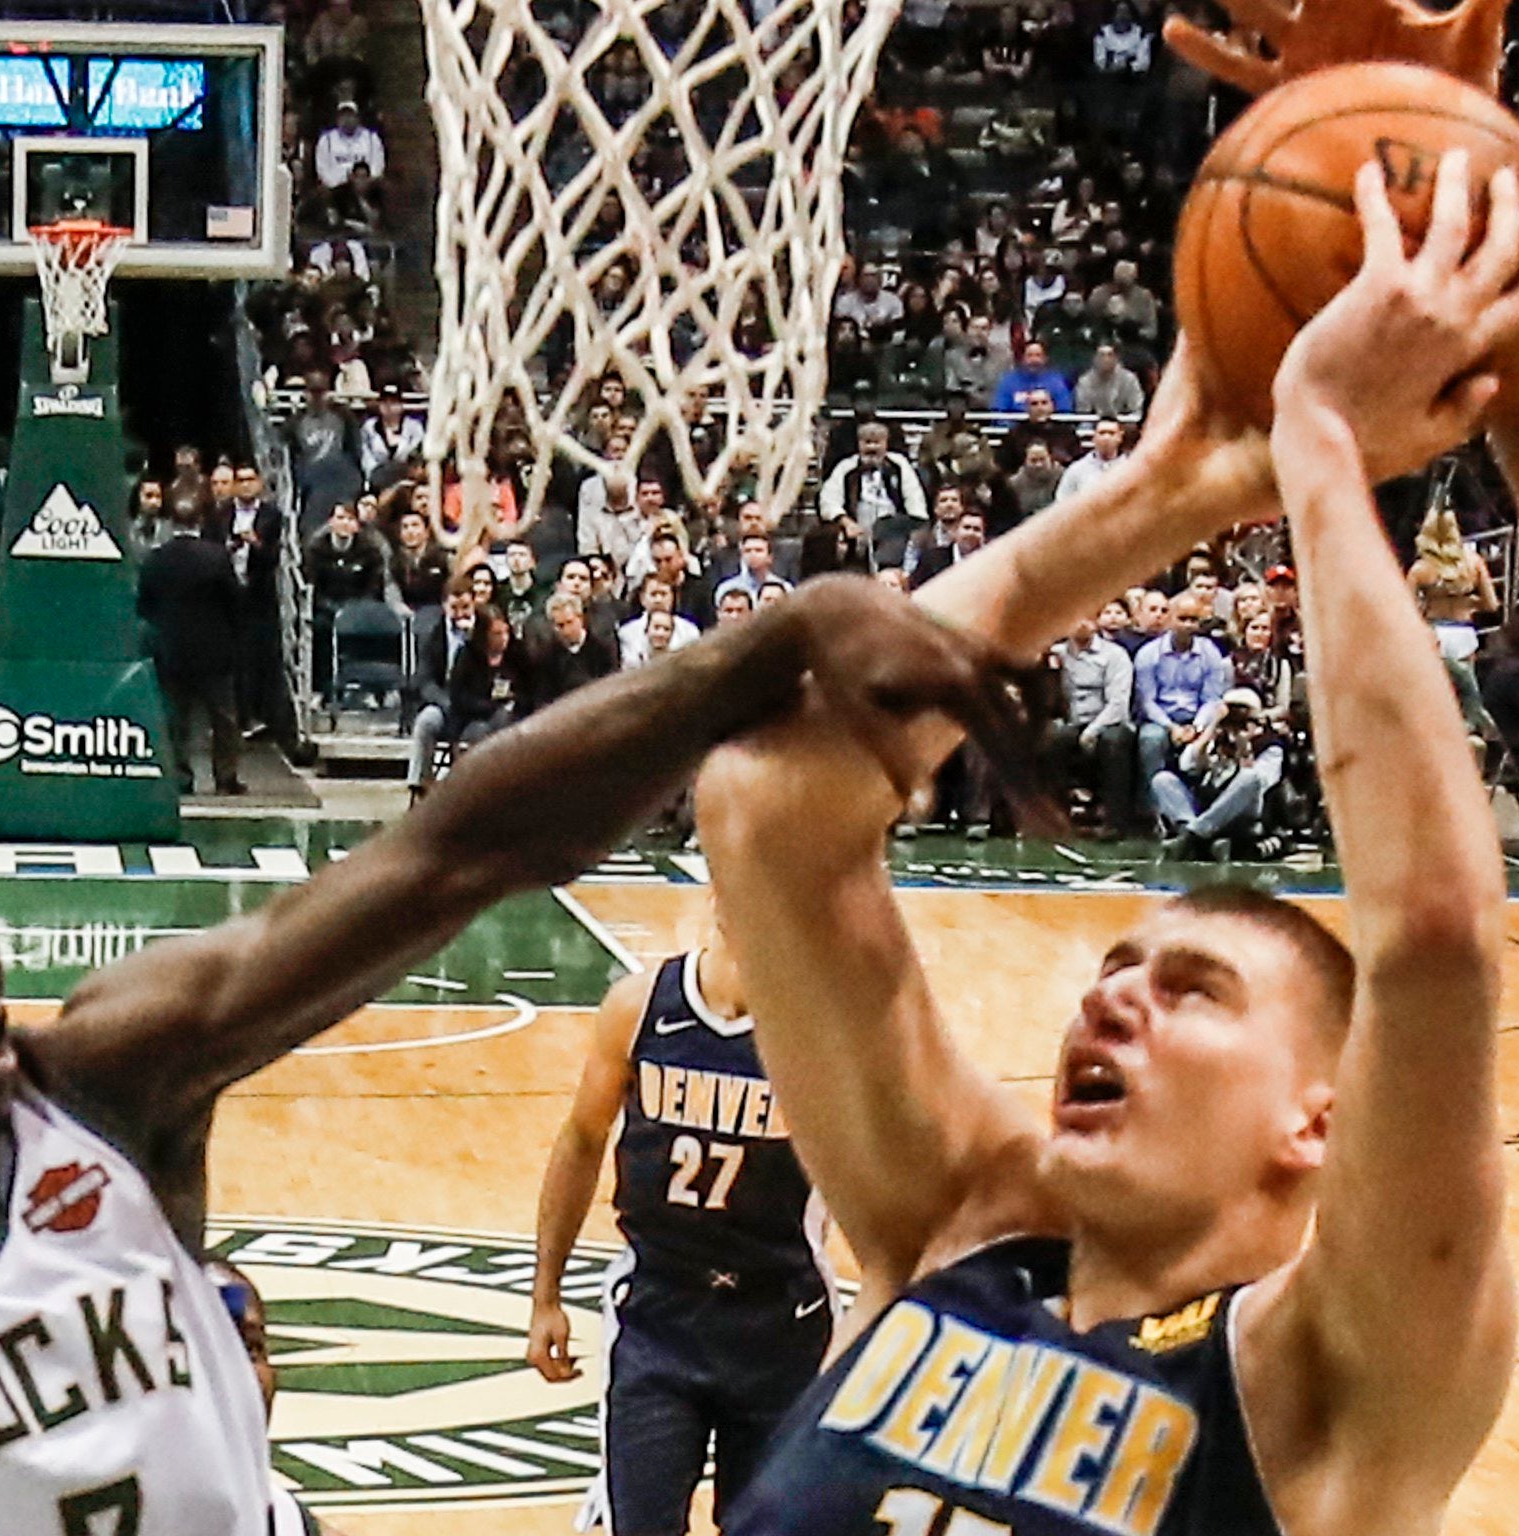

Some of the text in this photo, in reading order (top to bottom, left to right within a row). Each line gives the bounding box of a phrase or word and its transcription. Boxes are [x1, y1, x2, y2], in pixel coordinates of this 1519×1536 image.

[33, 508, 102, 536] Coors
[42, 537, 89, 550] LIGHT
[638, 1059, 791, 1138] DENVE
[666, 1135, 745, 1210] 27
